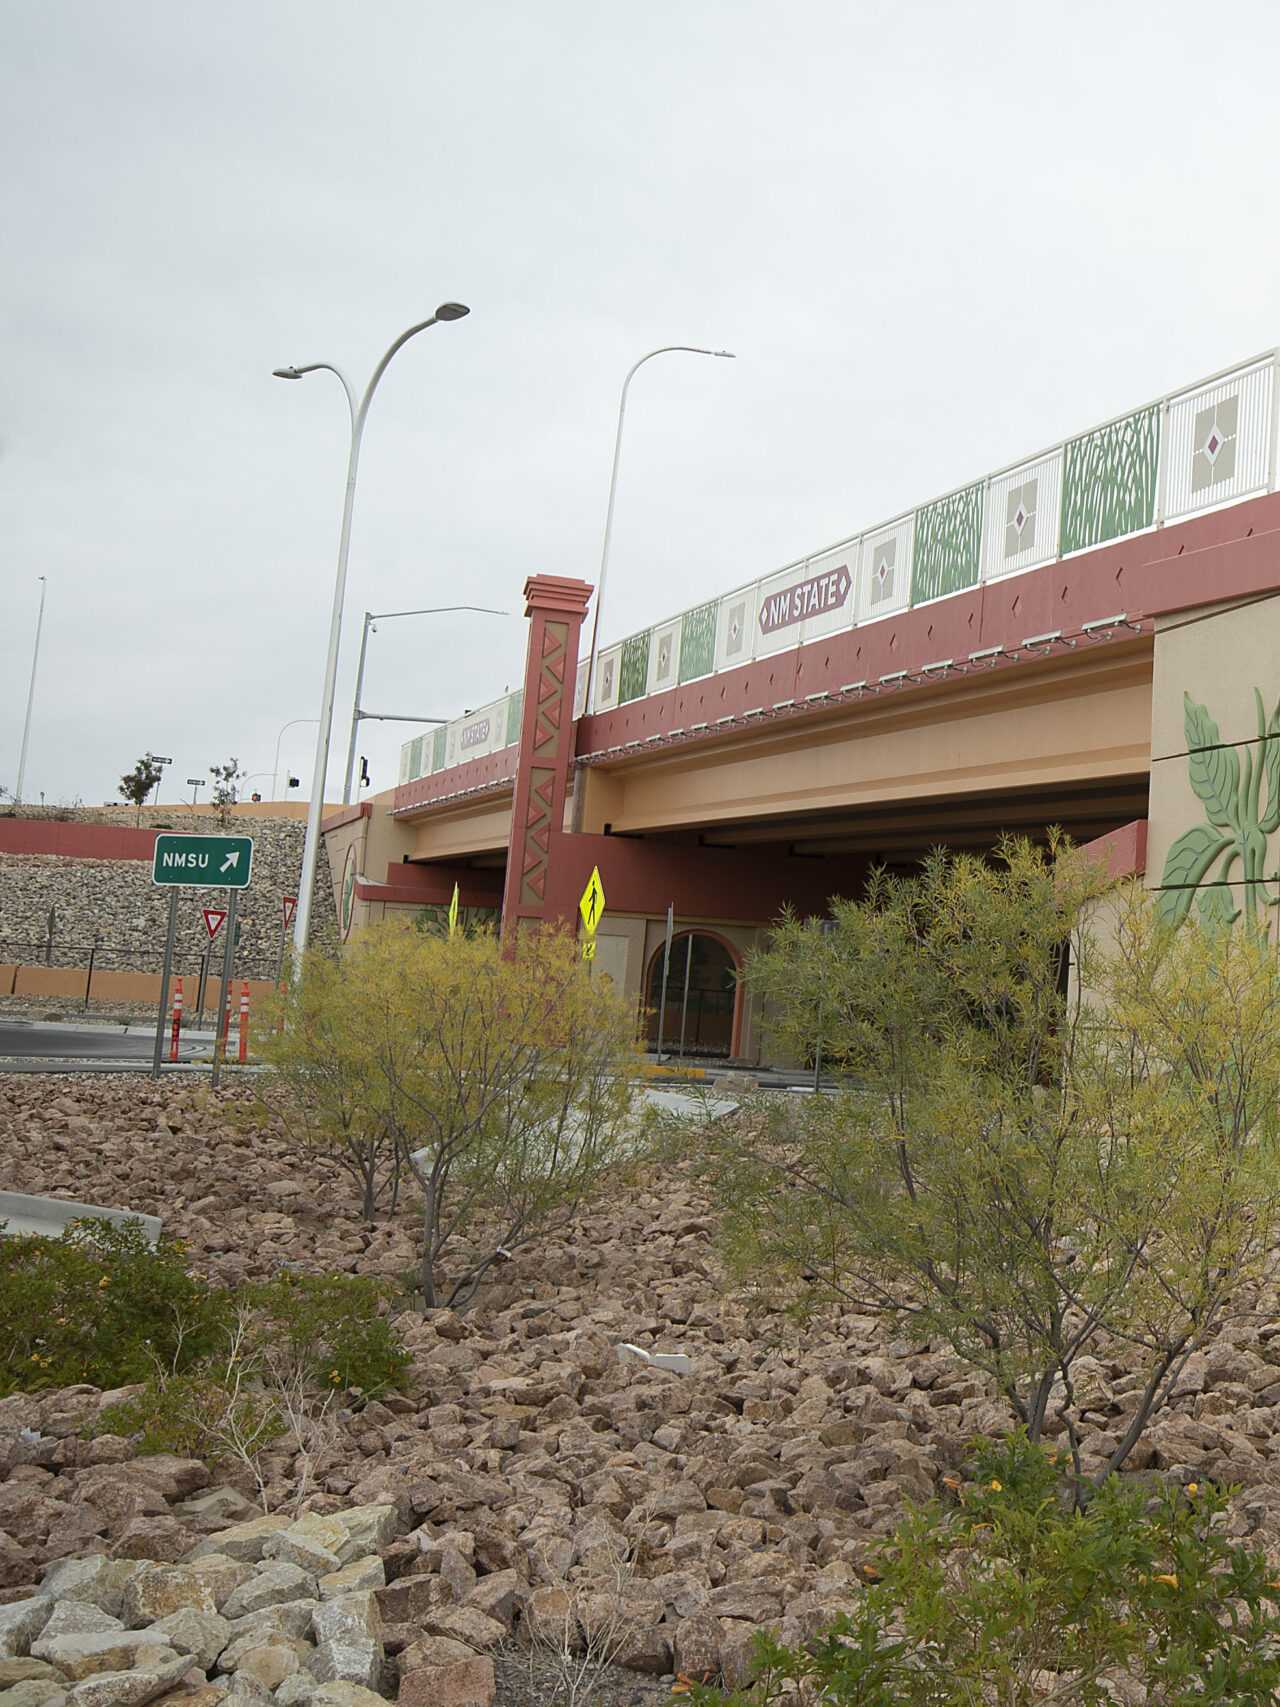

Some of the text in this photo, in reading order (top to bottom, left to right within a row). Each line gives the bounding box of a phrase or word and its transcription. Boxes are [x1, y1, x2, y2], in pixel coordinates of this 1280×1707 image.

[769, 573, 839, 627] NM STATE
[162, 852, 209, 868] NMSU
